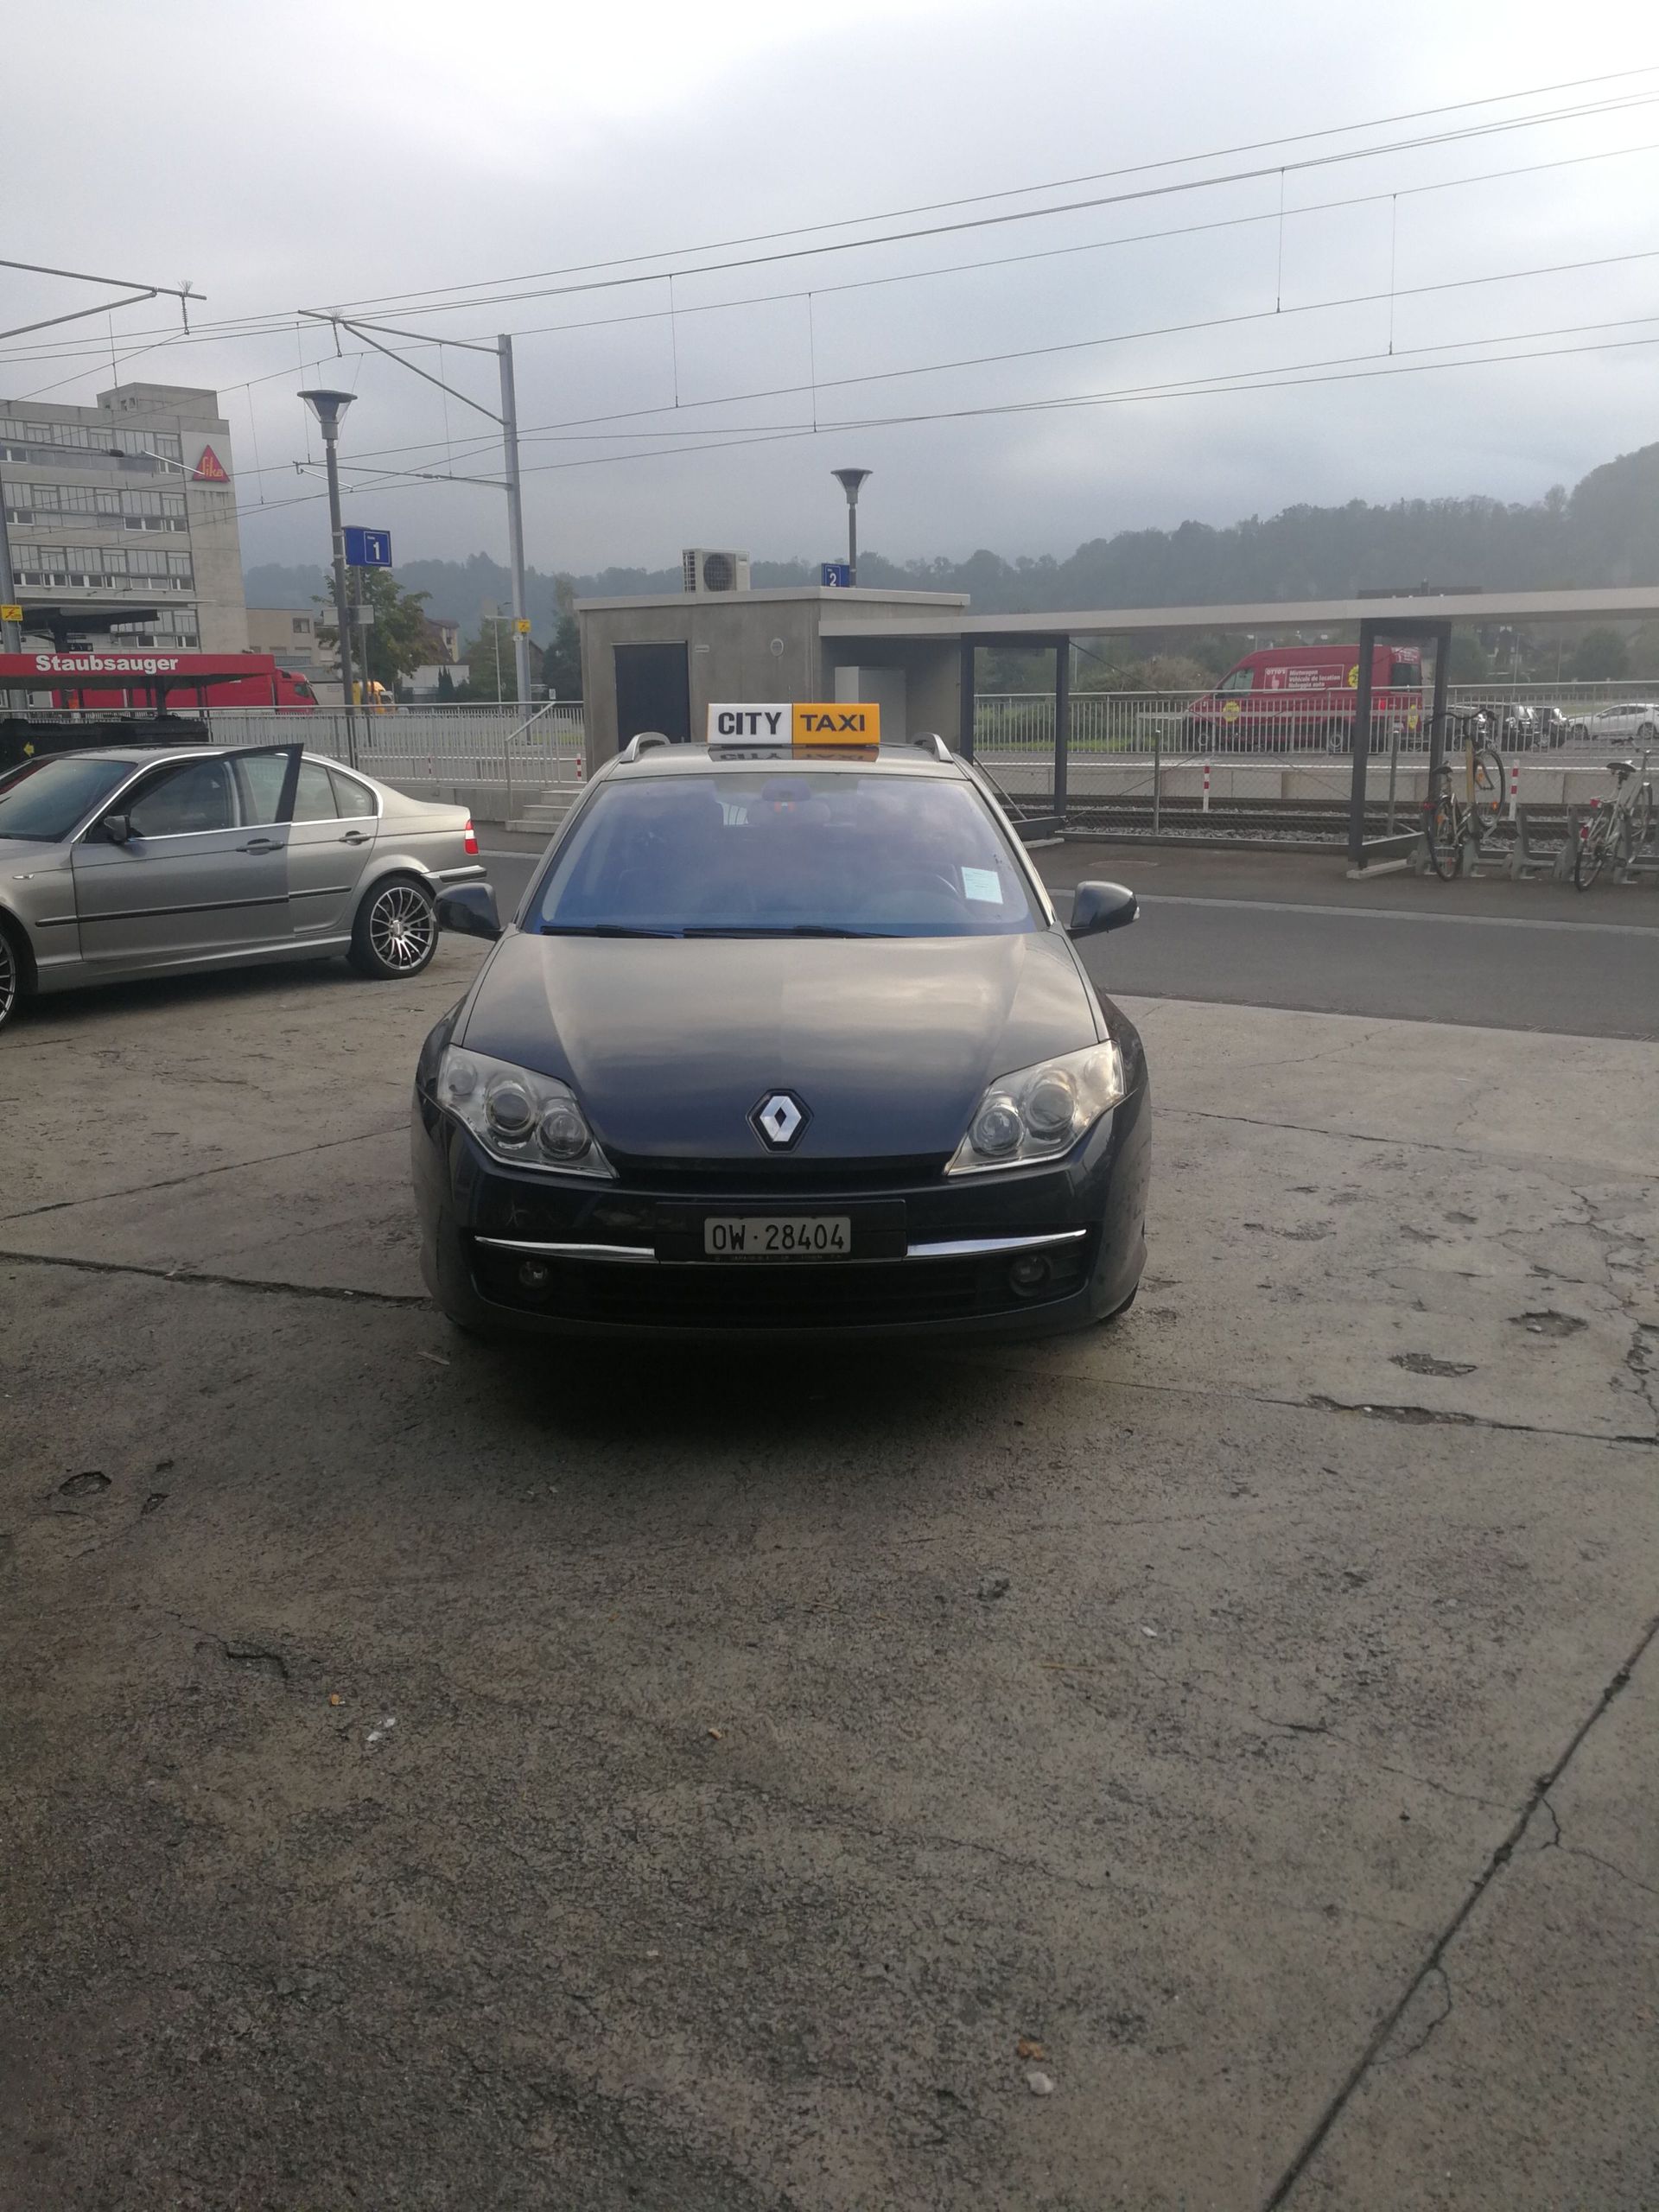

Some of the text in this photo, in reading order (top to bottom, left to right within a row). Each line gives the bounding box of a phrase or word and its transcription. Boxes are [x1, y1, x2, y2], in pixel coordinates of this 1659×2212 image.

[373, 542, 380, 560] 1
[830, 573, 837, 587] 2
[35, 655, 179, 675] Staubsauger
[718, 712, 866, 735] CITY TAXI
